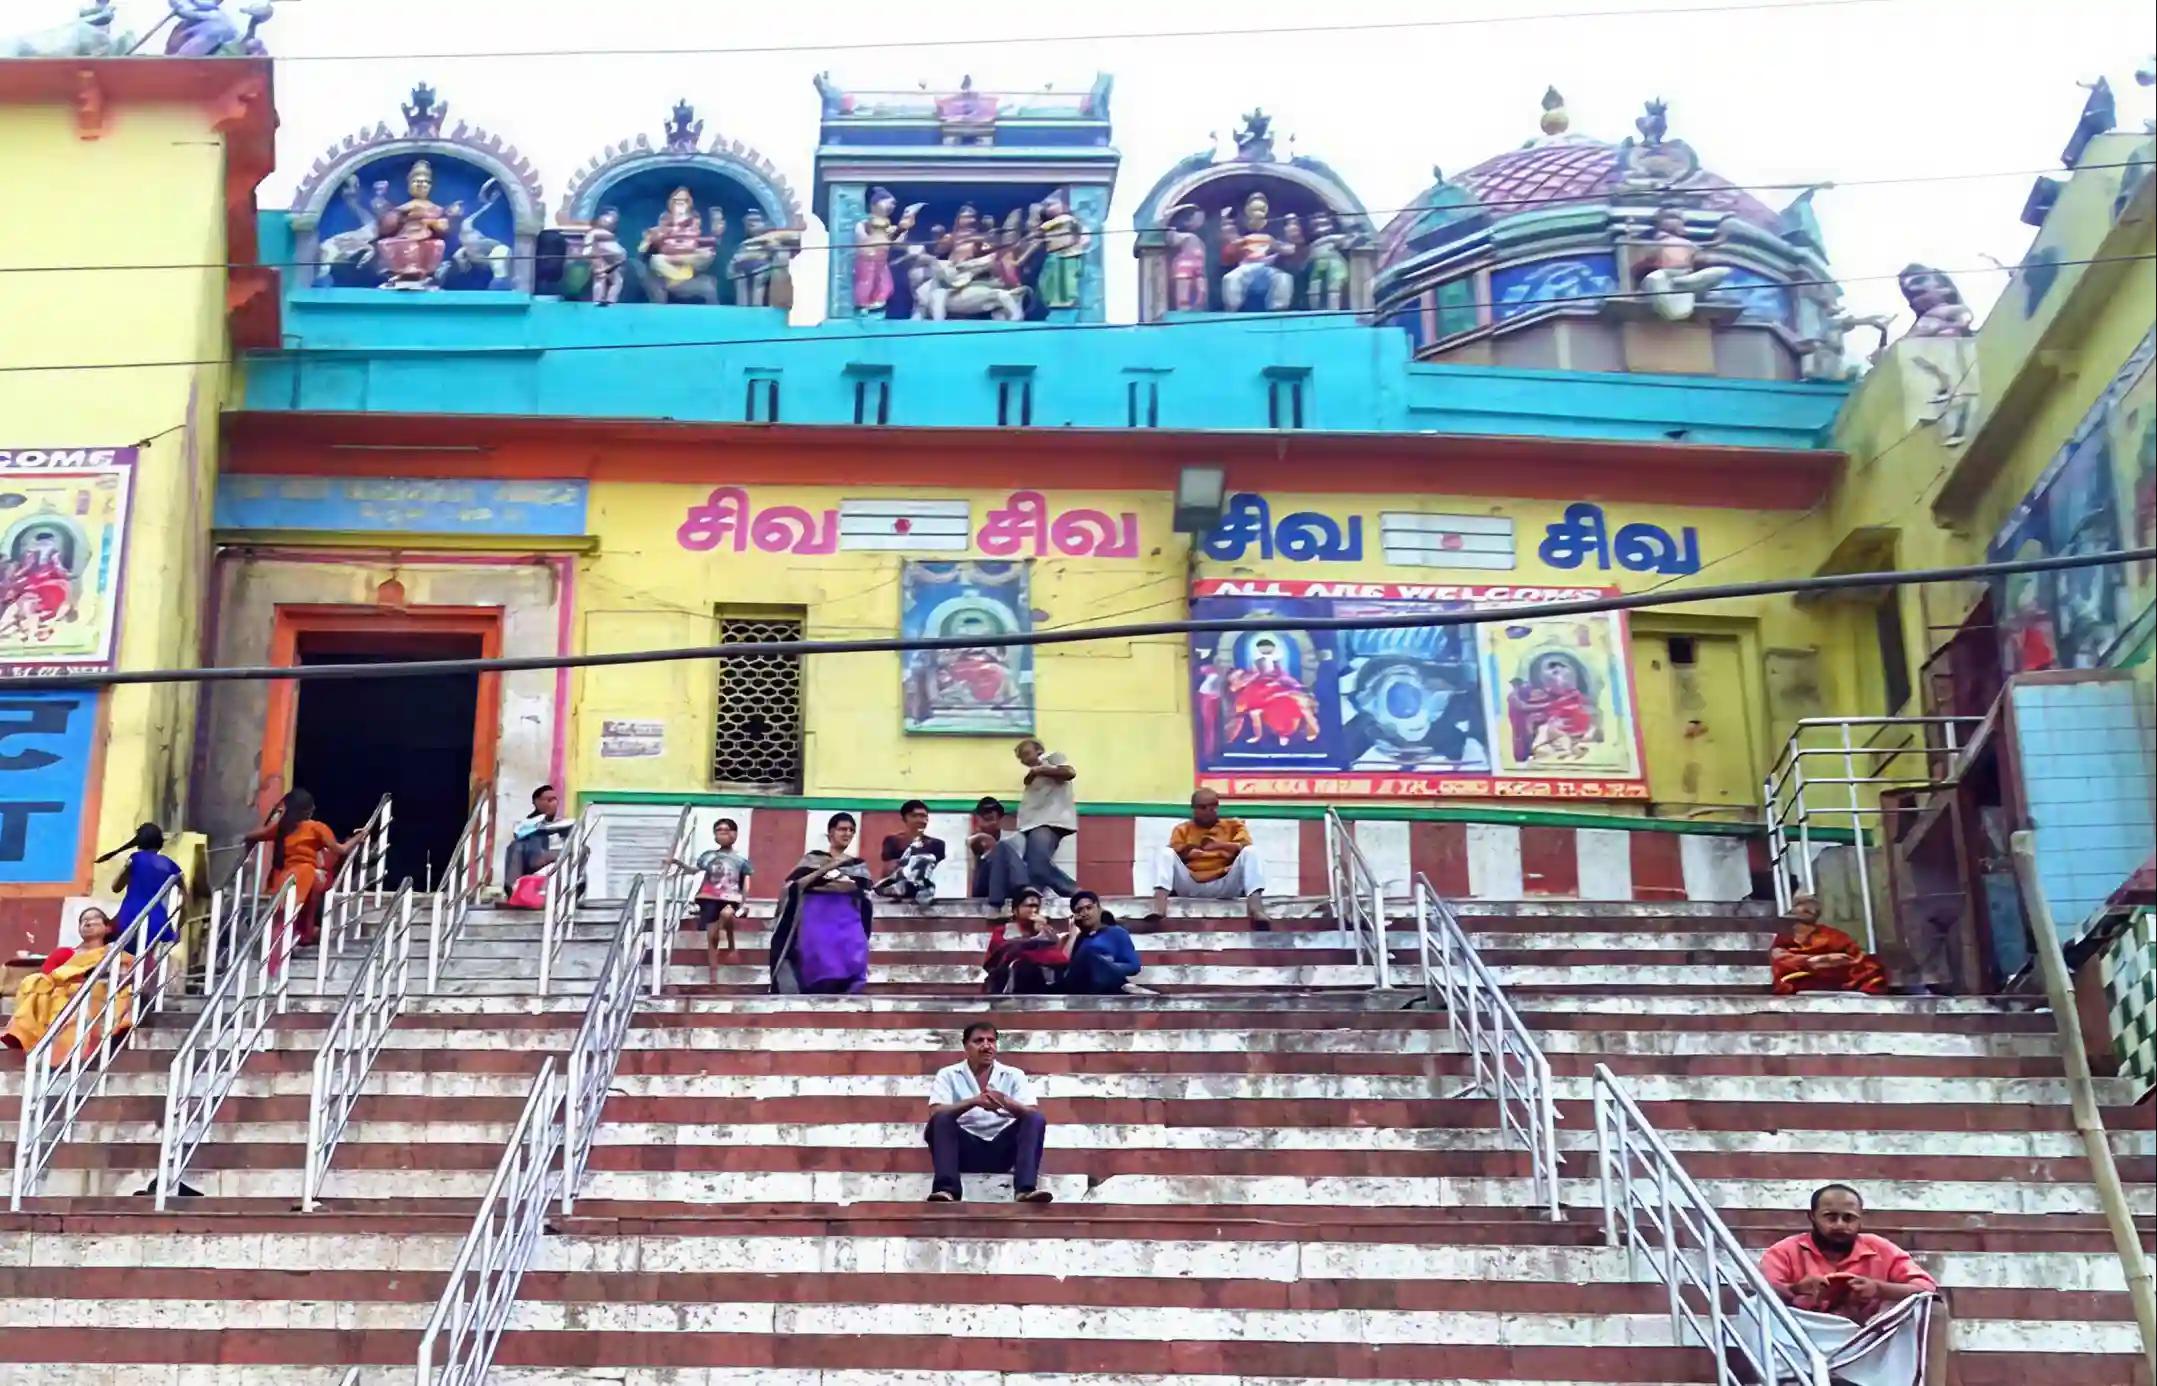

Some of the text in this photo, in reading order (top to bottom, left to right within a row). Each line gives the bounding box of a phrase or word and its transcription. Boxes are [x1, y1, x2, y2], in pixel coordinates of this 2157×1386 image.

[677, 487, 1701, 575] சிவ சிவ சிவ சிவ
[1213, 582, 1293, 597] ALL
[1304, 583, 1385, 599] ARE
